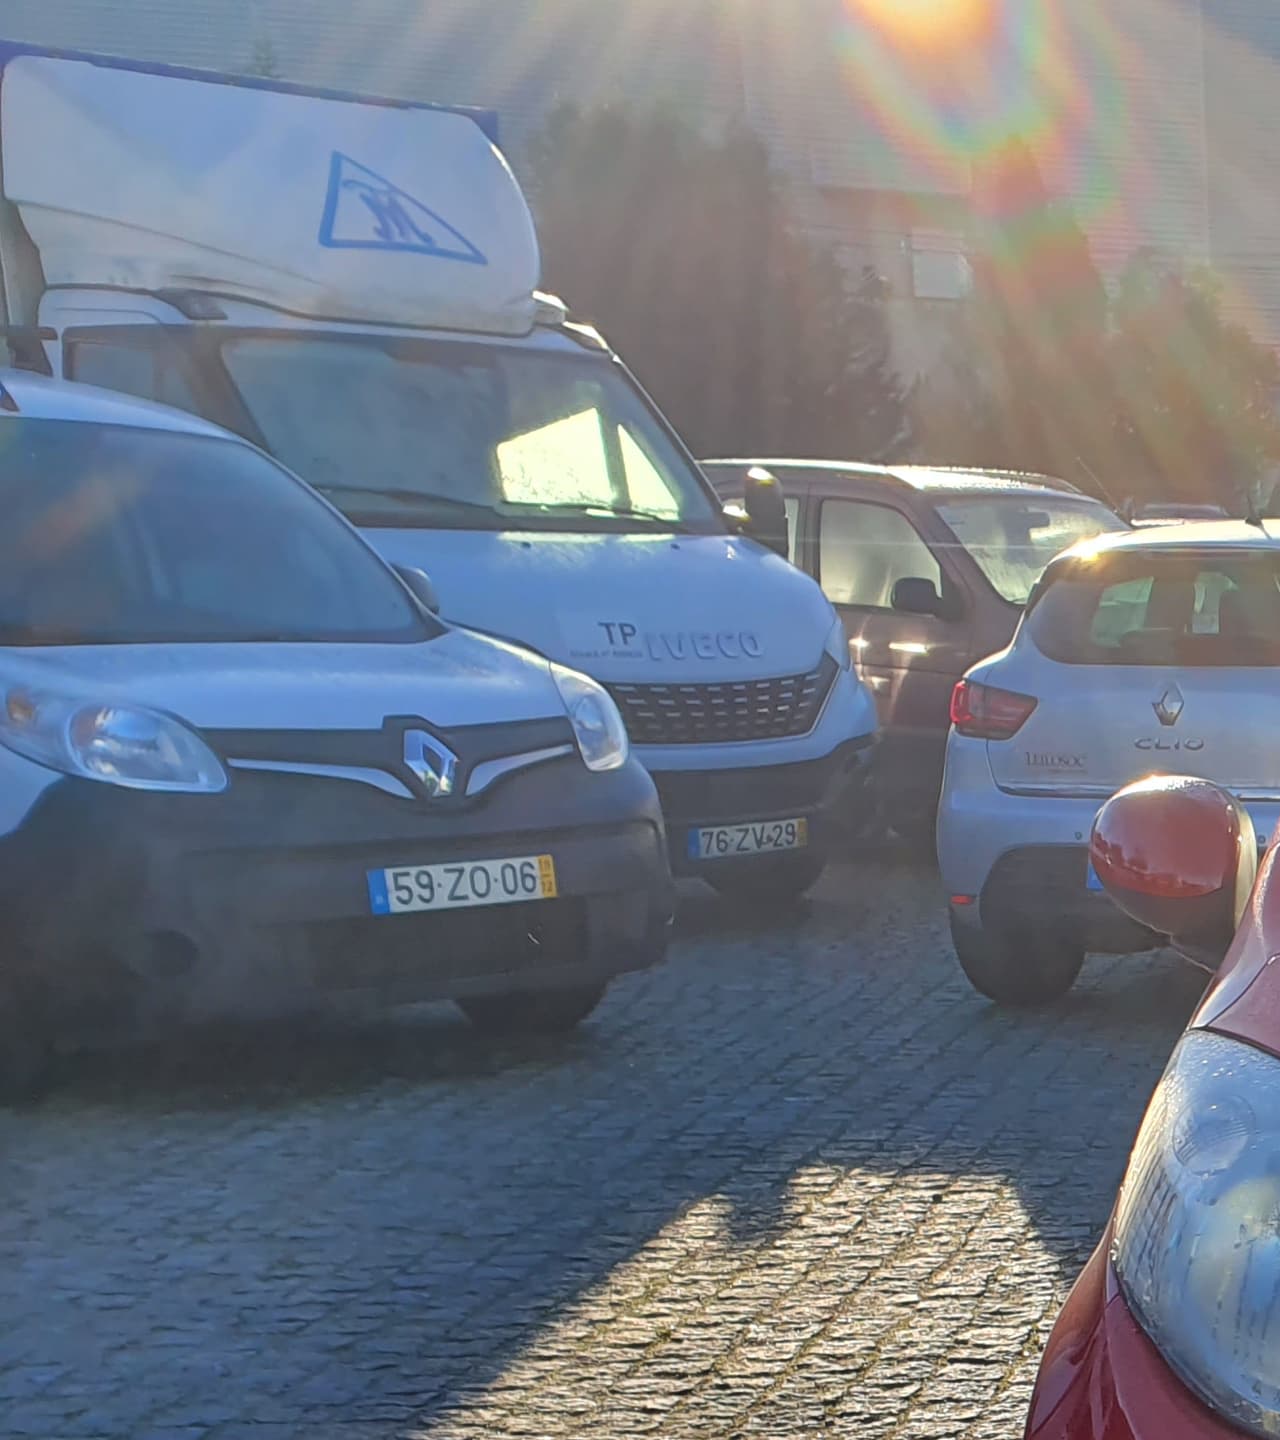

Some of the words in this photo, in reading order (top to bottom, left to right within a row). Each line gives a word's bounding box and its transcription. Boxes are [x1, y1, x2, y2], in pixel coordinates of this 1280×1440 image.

[598, 622, 637, 645] TP
[646, 632, 763, 661] IVECO
[1134, 737, 1204, 750] CLIO
